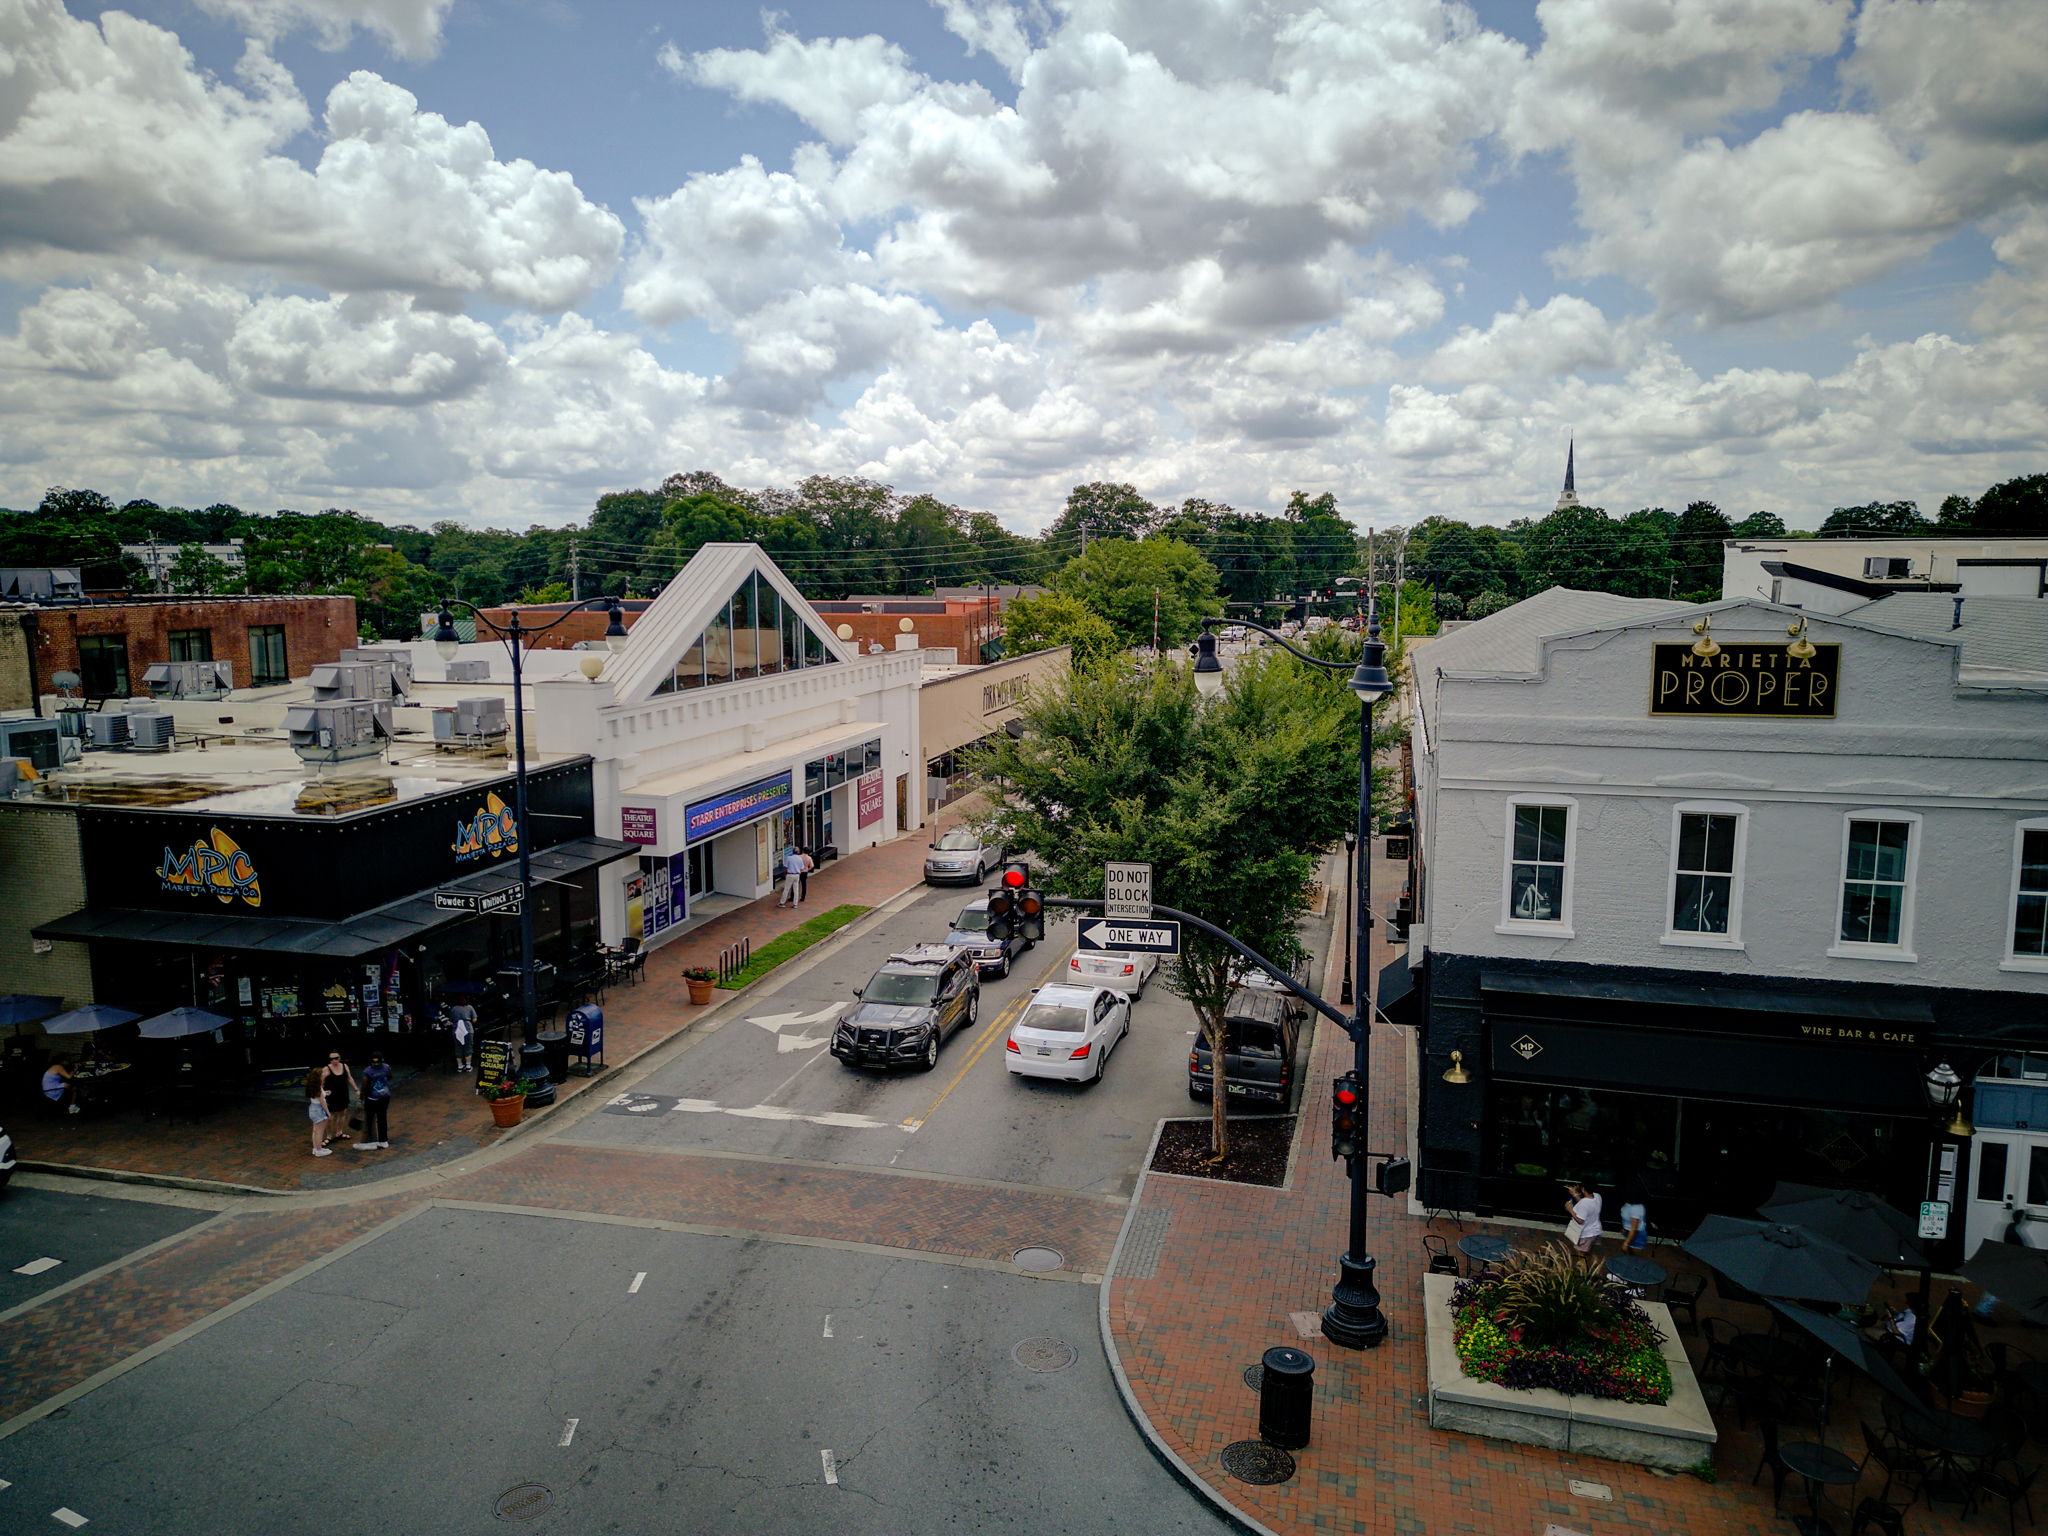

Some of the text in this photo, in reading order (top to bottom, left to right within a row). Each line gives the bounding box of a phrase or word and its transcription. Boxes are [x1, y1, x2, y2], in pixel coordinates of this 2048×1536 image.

[1681, 653, 1812, 668] MARIETTA
[1661, 670, 1828, 707] PROPER
[691, 783, 788, 829] STARR ENTERPRISES PRESENTS
[861, 795, 882, 816] SQUARE
[623, 814, 654, 822] THEATRE
[456, 806, 517, 853] MPC
[623, 830, 654, 838] SQUARE
[162, 846, 258, 886] MPC
[1109, 870, 1148, 883] DO NOT
[437, 895, 465, 907] Powder
[1108, 888, 1149, 901] BLOCK
[481, 893, 507, 910] Whitlock
[1108, 904, 1149, 914] INTERSECTION
[1109, 929, 1164, 944] ONE WAY
[1801, 1025, 1915, 1043] WINE BAR & CAFE
[1519, 1042, 1535, 1051] MP
[480, 1052, 506, 1061] COMEDY
[480, 1061, 505, 1070] SQUARE
[1922, 1204, 1929, 1214] 2
